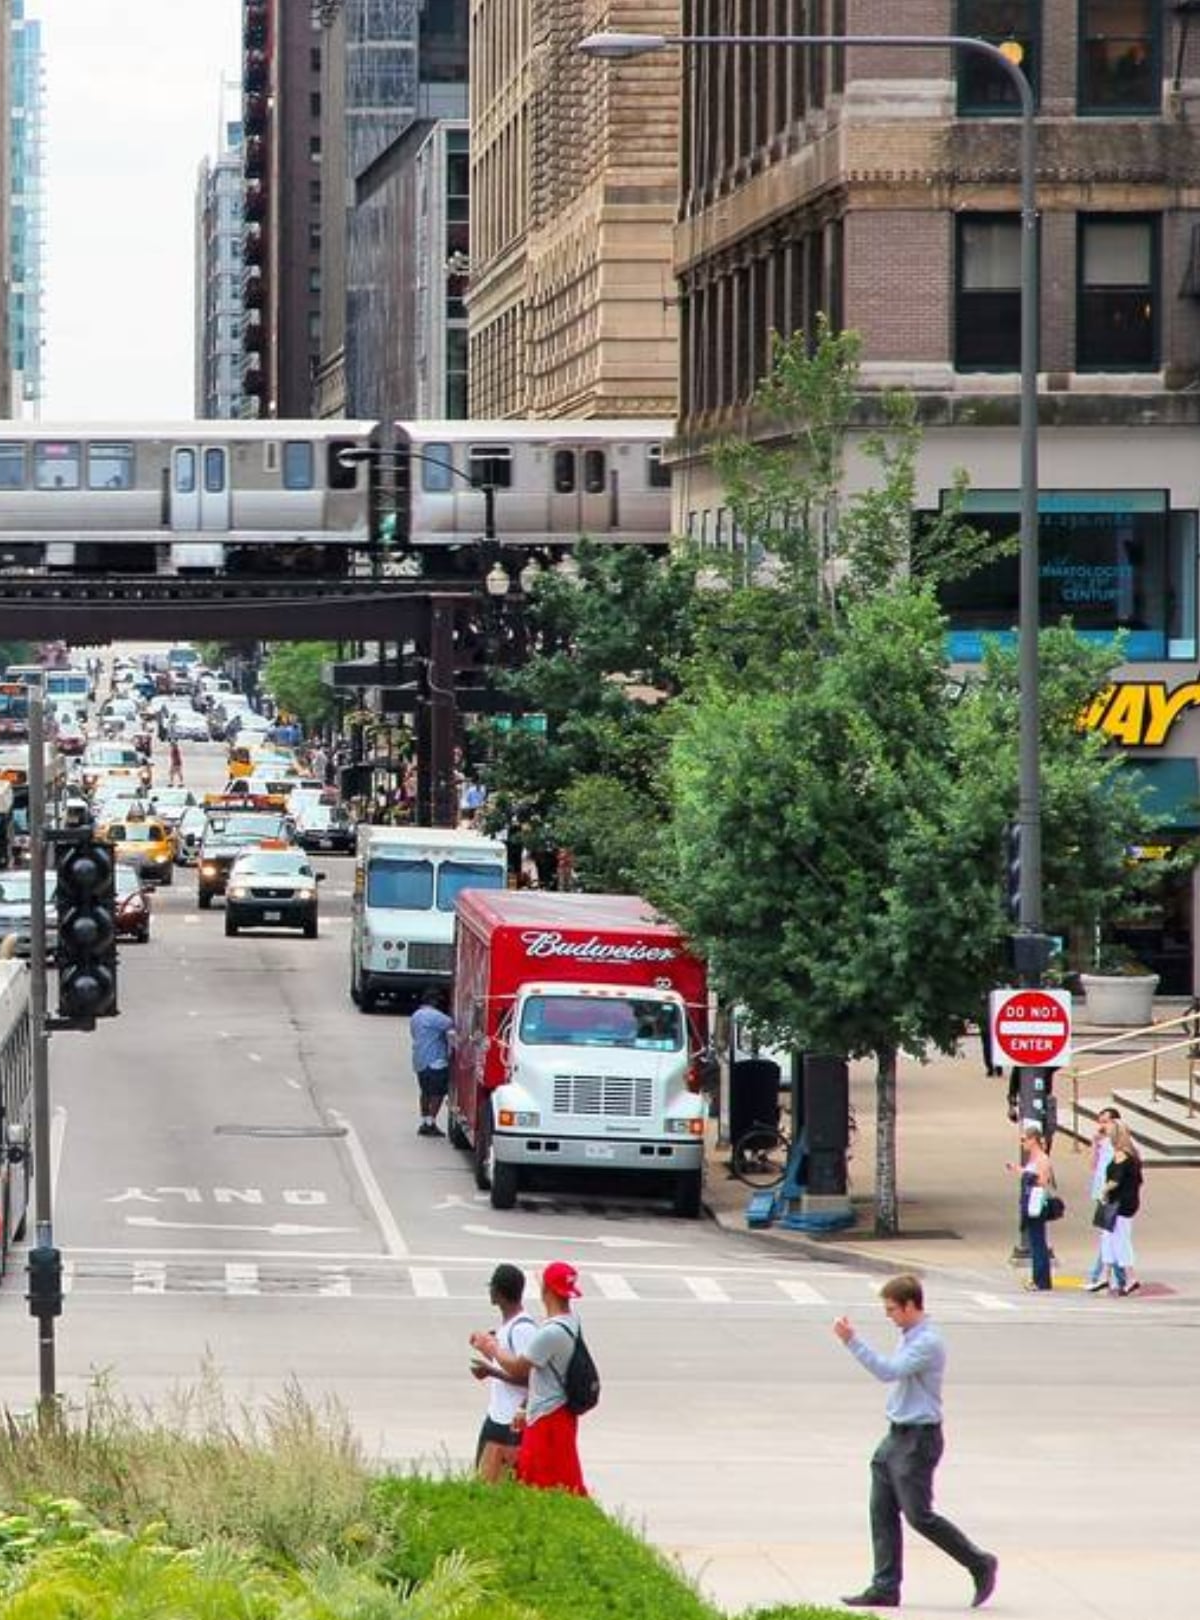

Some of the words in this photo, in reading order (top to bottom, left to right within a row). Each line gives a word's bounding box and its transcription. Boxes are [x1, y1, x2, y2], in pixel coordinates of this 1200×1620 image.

[521, 931, 676, 961] Budweiser
[1005, 1005, 1025, 1018] DO
[1029, 1005, 1058, 1018] NOT
[1010, 1038, 1054, 1051] ENTER
